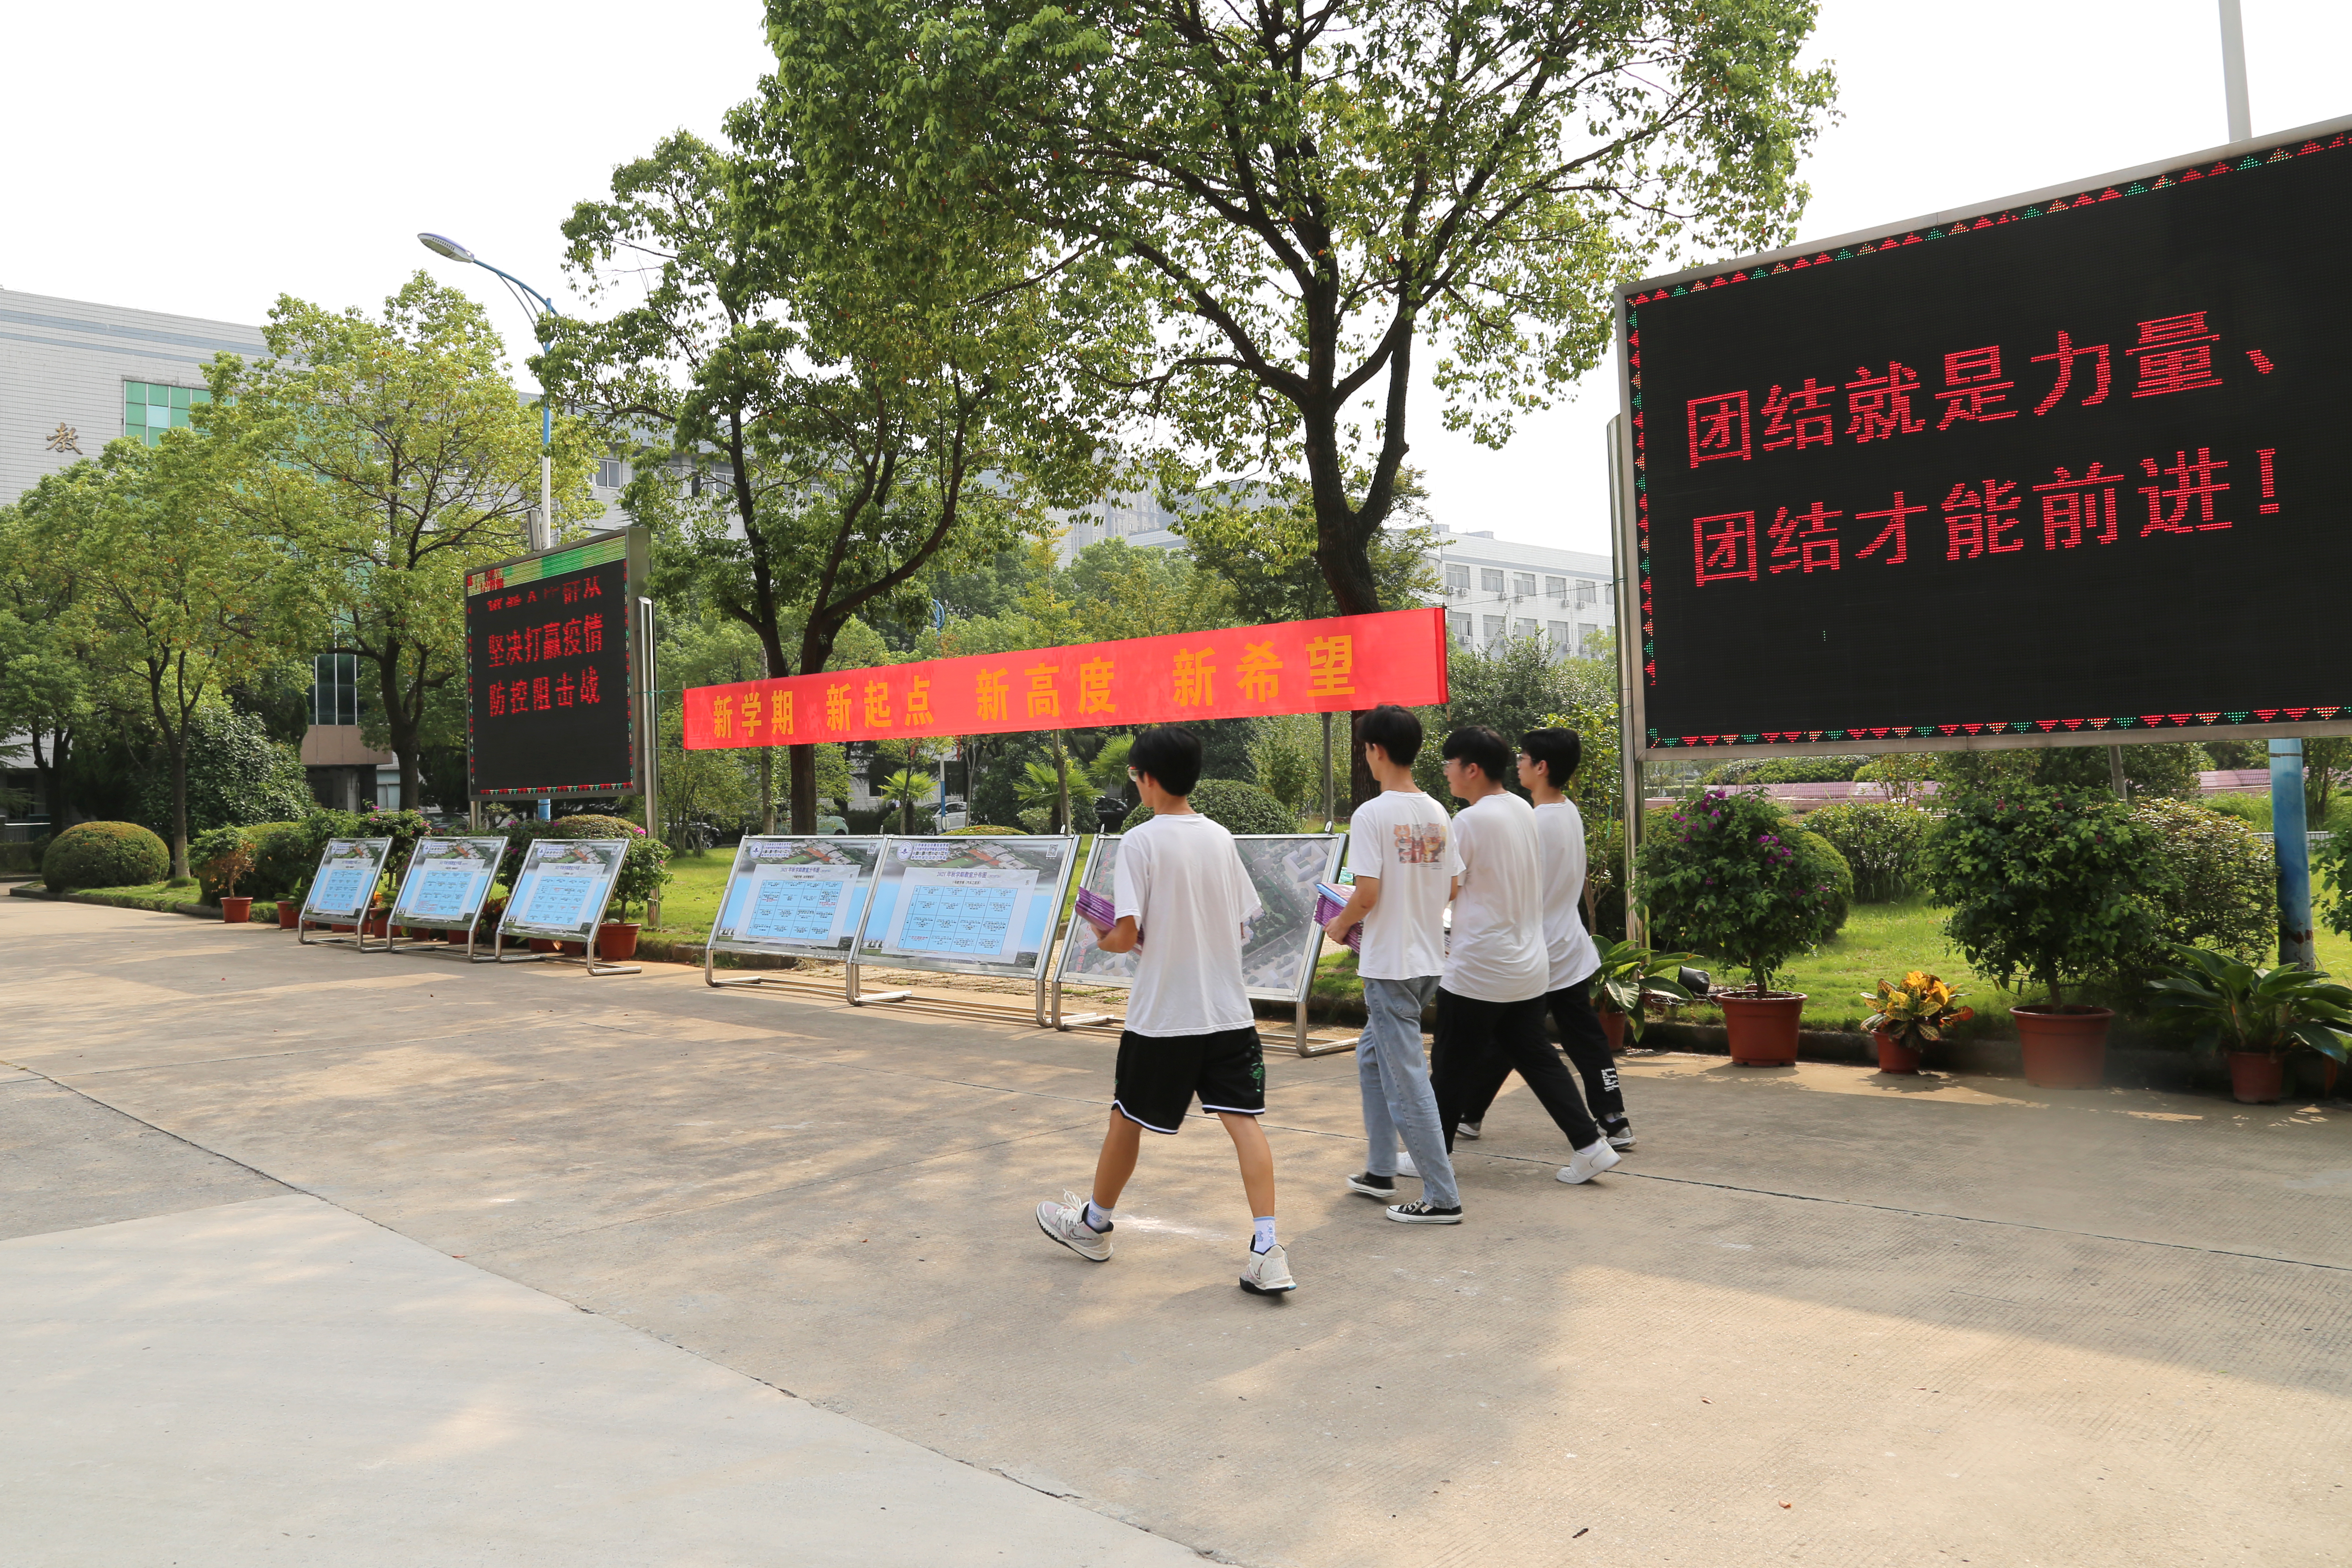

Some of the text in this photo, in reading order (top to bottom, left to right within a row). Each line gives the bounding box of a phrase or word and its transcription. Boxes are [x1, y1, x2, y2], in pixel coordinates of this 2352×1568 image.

[1686, 311, 2274, 469] 团结就是力量、
[489, 613, 604, 668] 坚决打赢疫情
[489, 666, 600, 717] 防控阻击战
[713, 635, 1356, 739] 新学期 新起点 新高度 新希望
